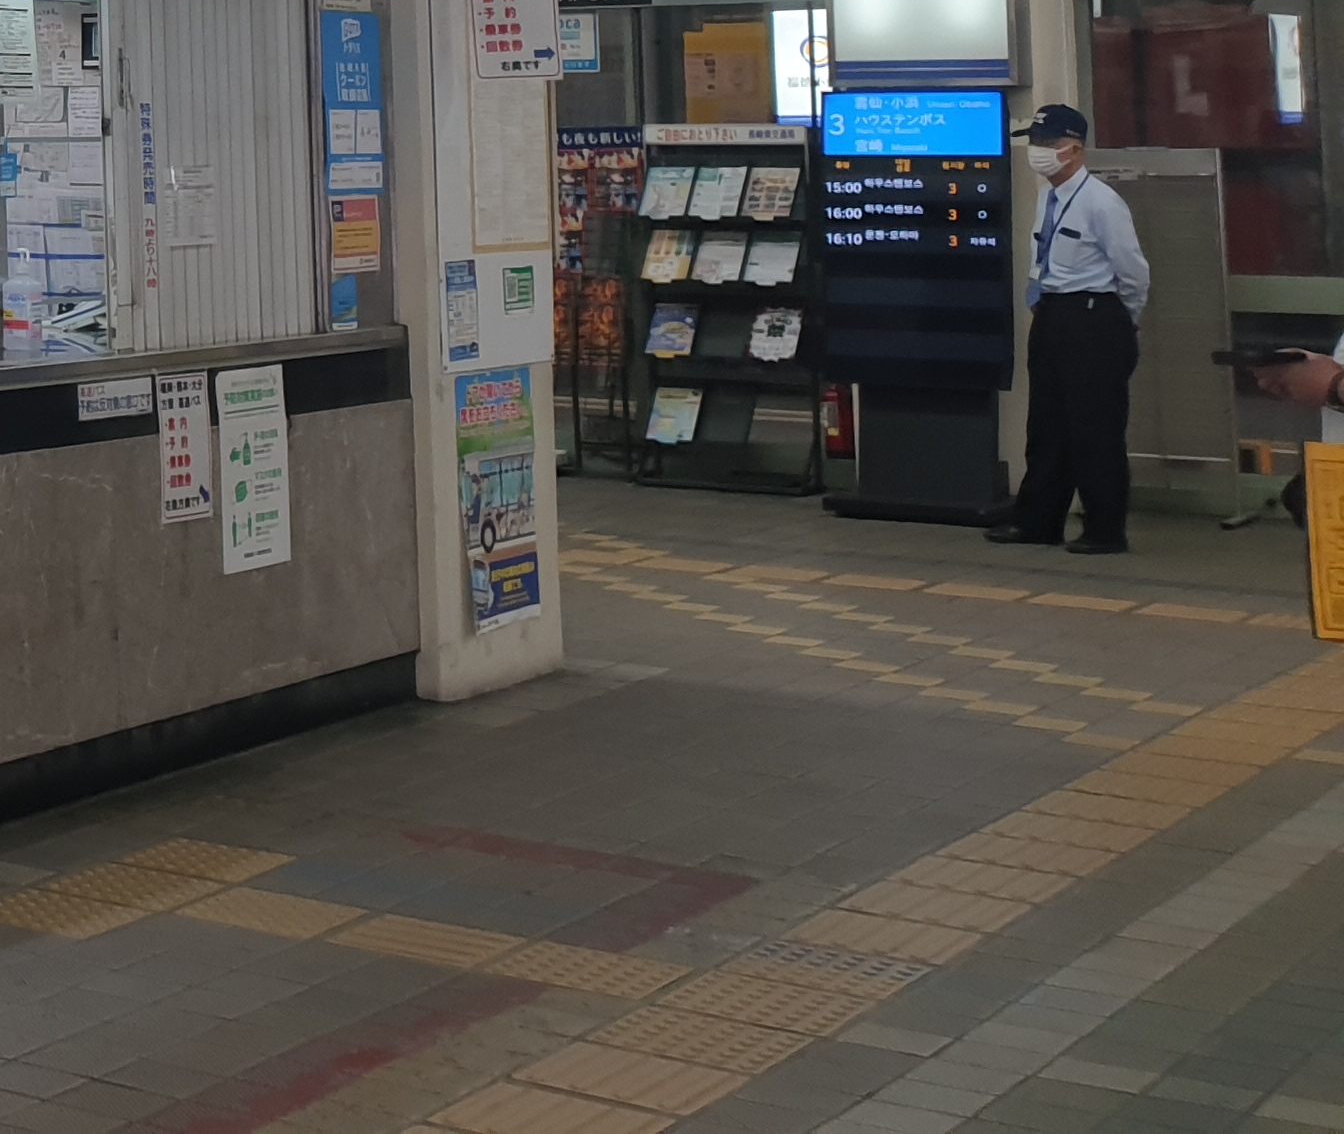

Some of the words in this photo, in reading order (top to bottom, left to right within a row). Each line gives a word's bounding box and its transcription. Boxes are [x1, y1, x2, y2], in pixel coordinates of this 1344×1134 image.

[828, 113, 845, 136] 3
[854, 114, 946, 126] ハウステンボス
[657, 128, 738, 142] ご自由におとり下さい
[855, 139, 883, 152] 宮崎
[825, 181, 862, 194] 15:00
[824, 207, 862, 220] 16:00
[825, 232, 862, 246] 16:10
